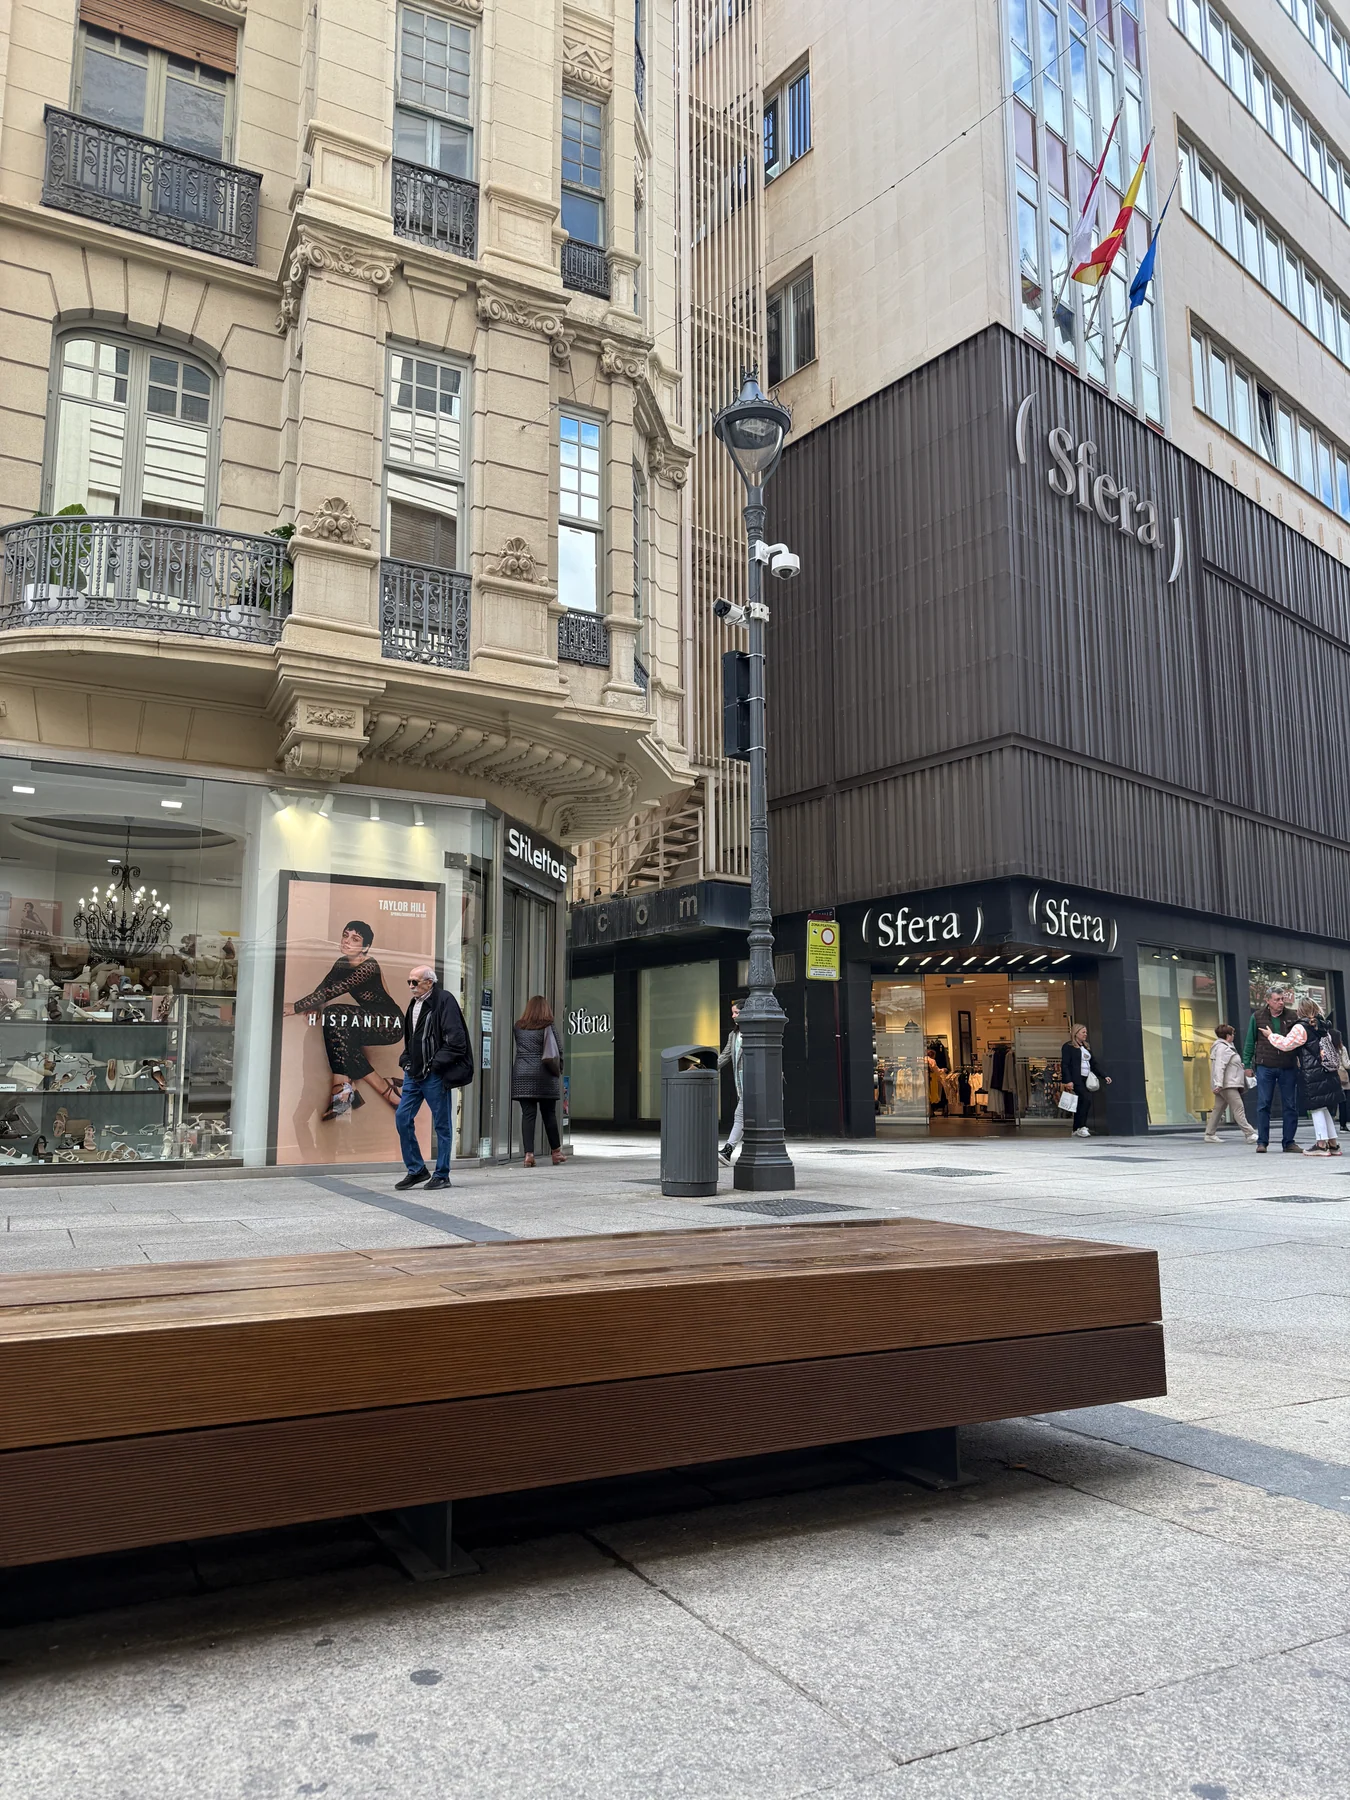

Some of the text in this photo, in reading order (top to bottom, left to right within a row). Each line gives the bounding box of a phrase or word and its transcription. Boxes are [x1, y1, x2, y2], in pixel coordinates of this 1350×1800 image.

[509, 828, 567, 883] Stilettos
[379, 900, 426, 913] TAYLOR HILL
[309, 1014, 402, 1029] HISPANITA
